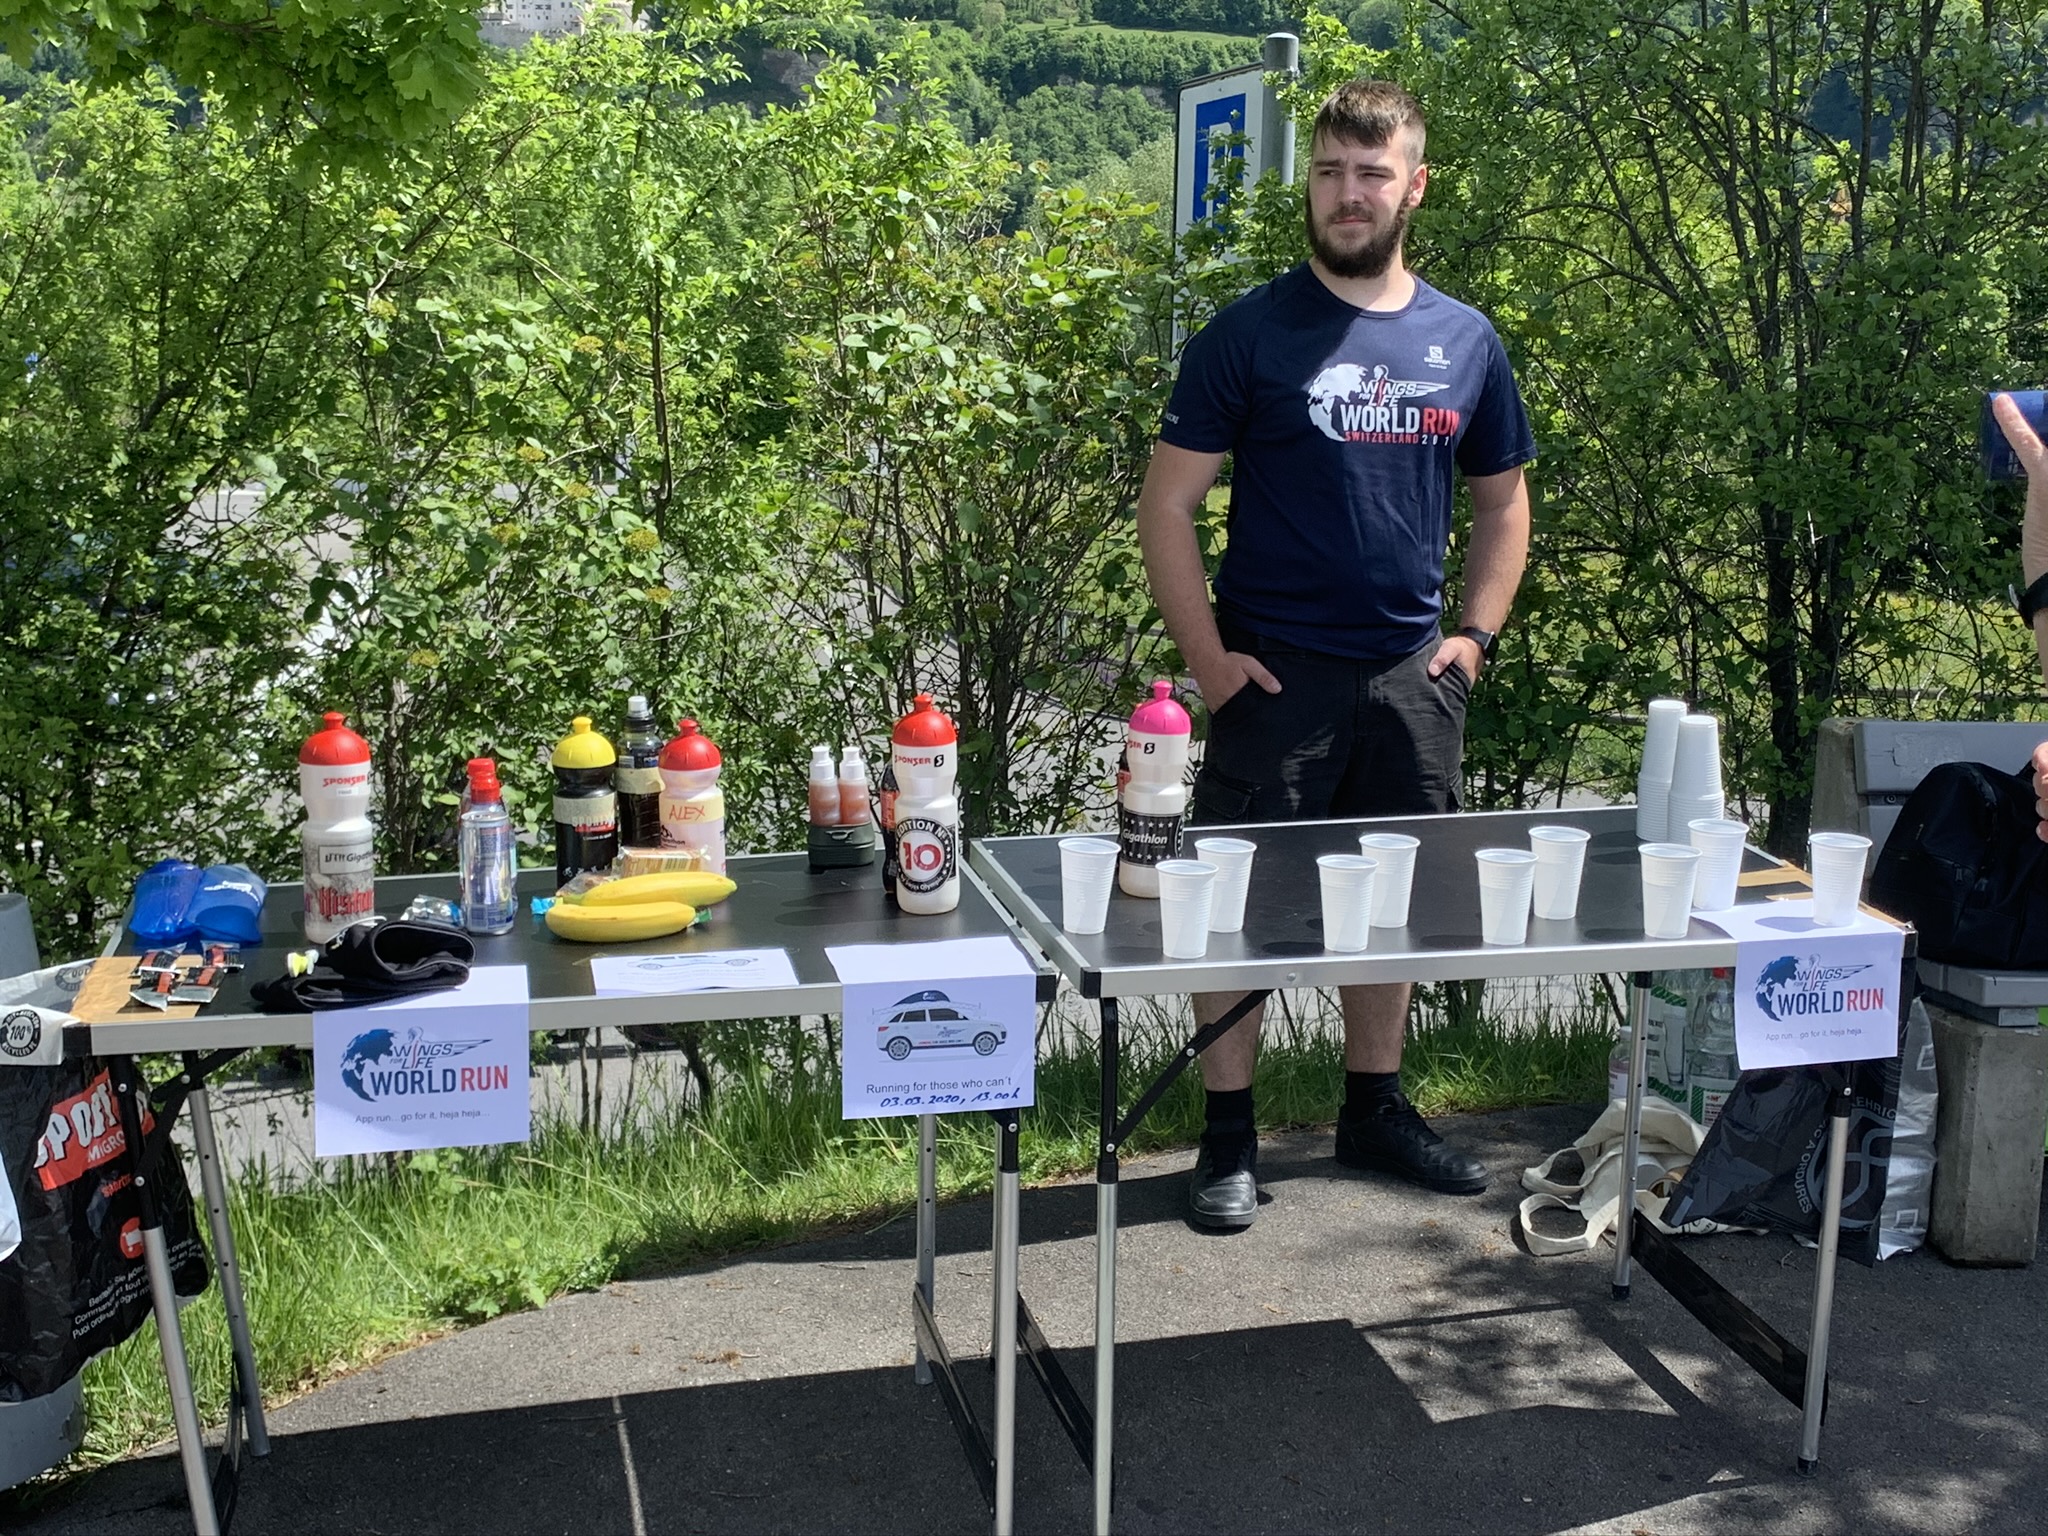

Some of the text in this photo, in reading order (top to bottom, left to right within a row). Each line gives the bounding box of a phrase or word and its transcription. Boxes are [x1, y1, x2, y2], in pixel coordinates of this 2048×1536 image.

[1361, 380, 1417, 394] WINGS
[1368, 395, 1400, 407] LIFE
[1340, 404, 1420, 433] WORLD
[1345, 431, 1419, 444] SWITZERLAND
[895, 754, 931, 766] SPONSER
[669, 804, 706, 821] ALEX
[1122, 829, 1168, 845] Gigathlon
[903, 842, 942, 871] 10
[1797, 968, 1843, 981] WINGS
[1802, 980, 1829, 992] LIFE
[1778, 988, 1884, 1017] WORLD RUN
[393, 1043, 453, 1057] WINGS
[401, 1056, 436, 1070] LIFE
[370, 1064, 508, 1096] WORLD RUN
[866, 1083, 910, 1095] Running
[913, 1081, 927, 1091] for
[930, 1080, 959, 1090] those
[961, 1079, 983, 1089] who
[355, 1115, 374, 1125] App
[415, 1111, 427, 1120] for
[440, 1110, 459, 1121] heja
[87, 1130, 125, 1163] MIGRO
[1794, 1152, 1813, 1214] ORDURES
